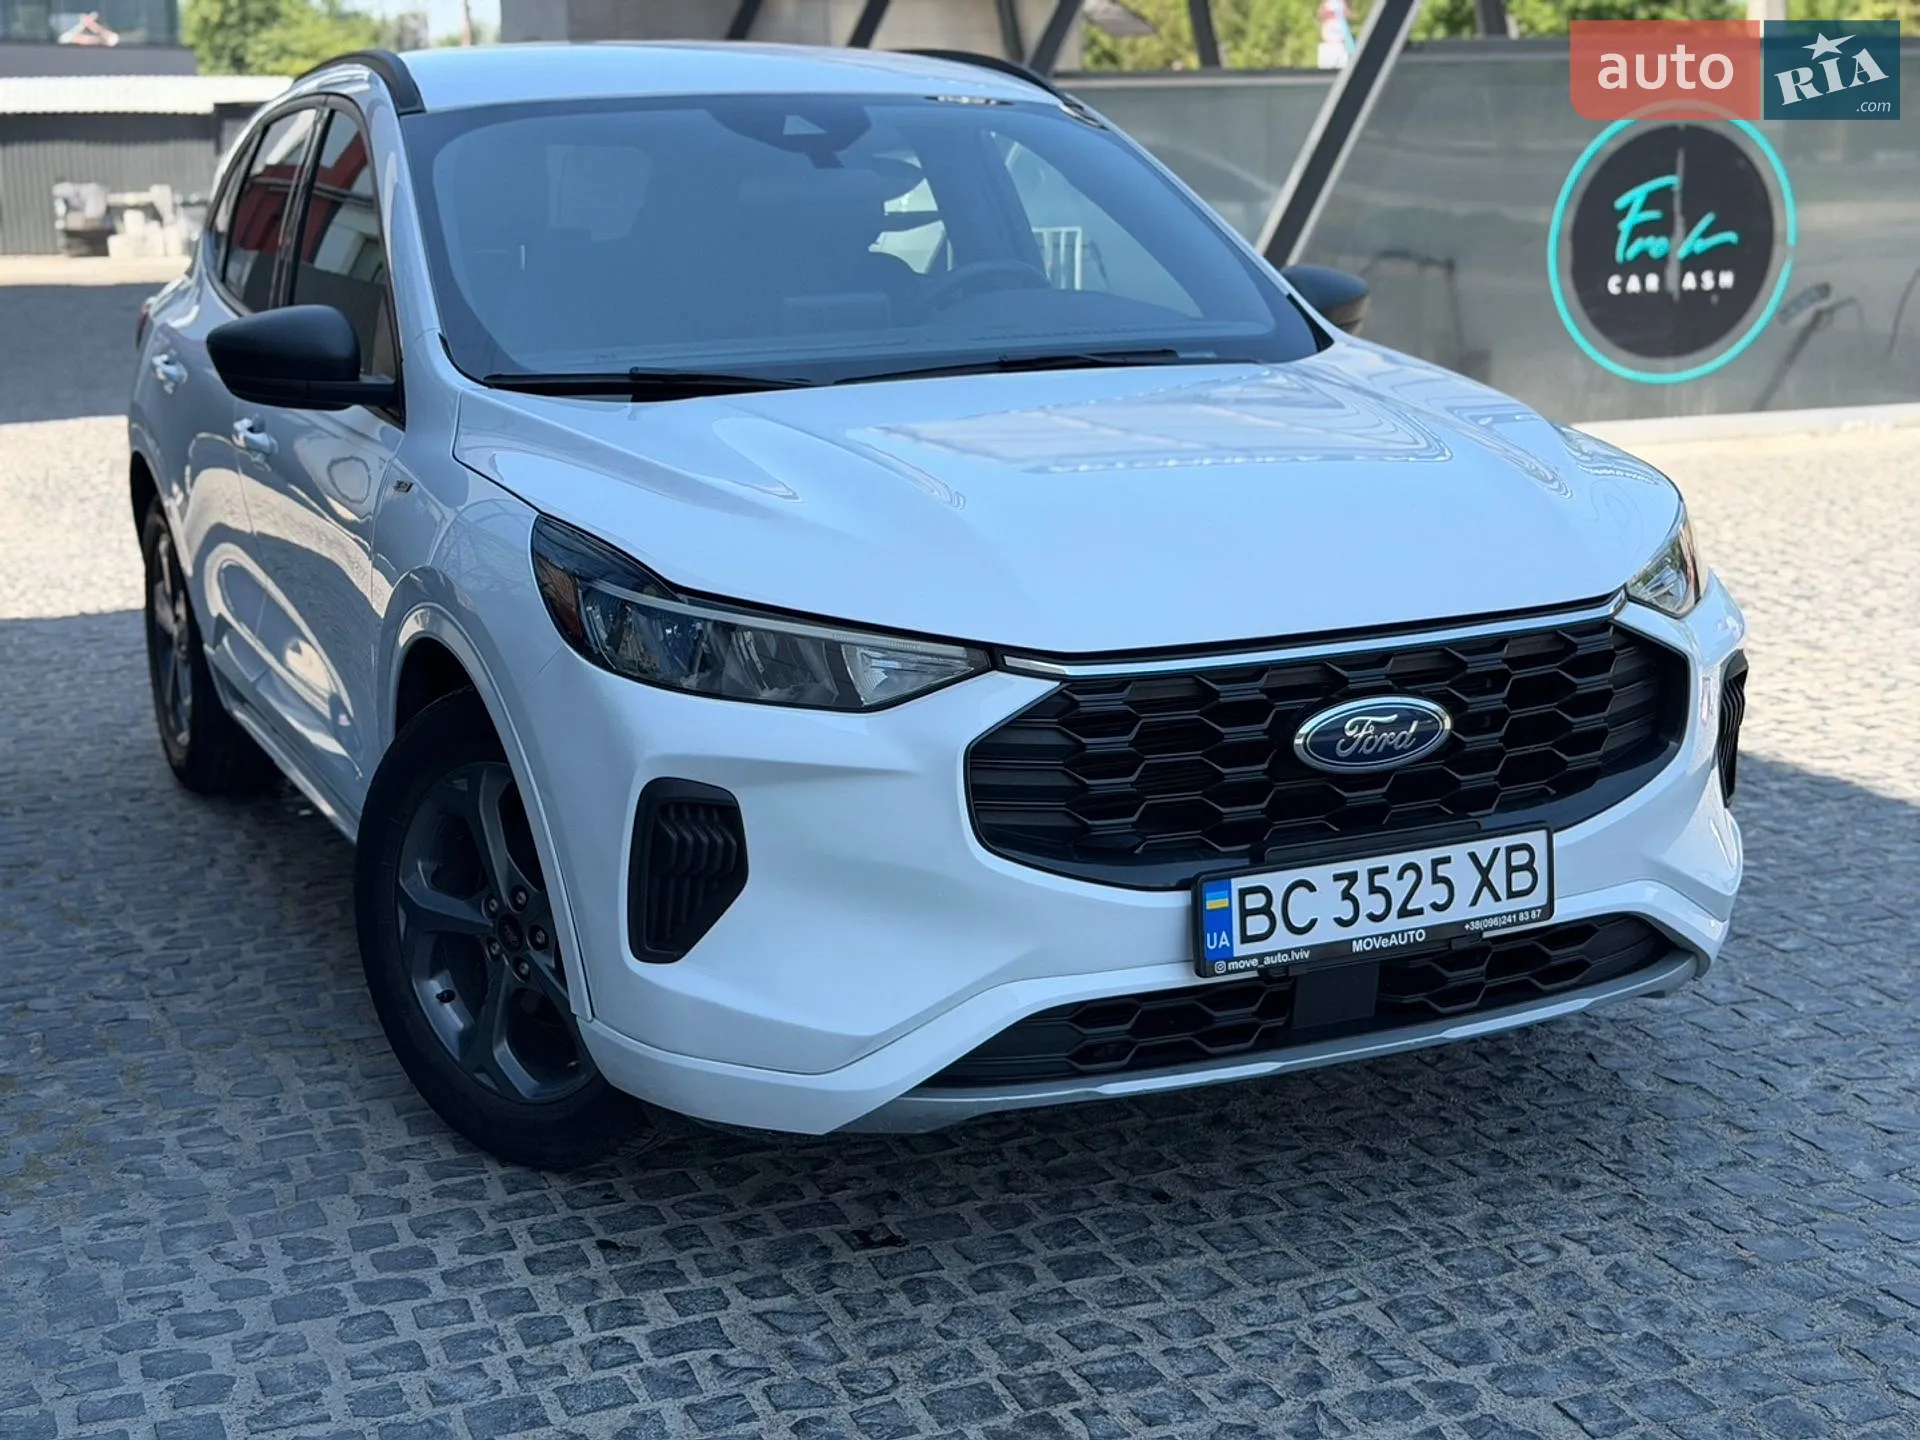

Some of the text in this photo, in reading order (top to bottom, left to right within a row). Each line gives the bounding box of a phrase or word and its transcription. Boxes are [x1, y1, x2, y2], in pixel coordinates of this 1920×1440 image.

[1607, 269, 1735, 295] CAR ASH
[1336, 714, 1418, 757] Ford
[1238, 842, 1539, 944] BC 3525 XB
[1519, 910, 1532, 921] 83
[1531, 908, 1542, 919] 87
[1206, 930, 1230, 950] UA
[1352, 929, 1426, 953] MOVeAUTO
[1228, 949, 1310, 971] move_auto.lviv
